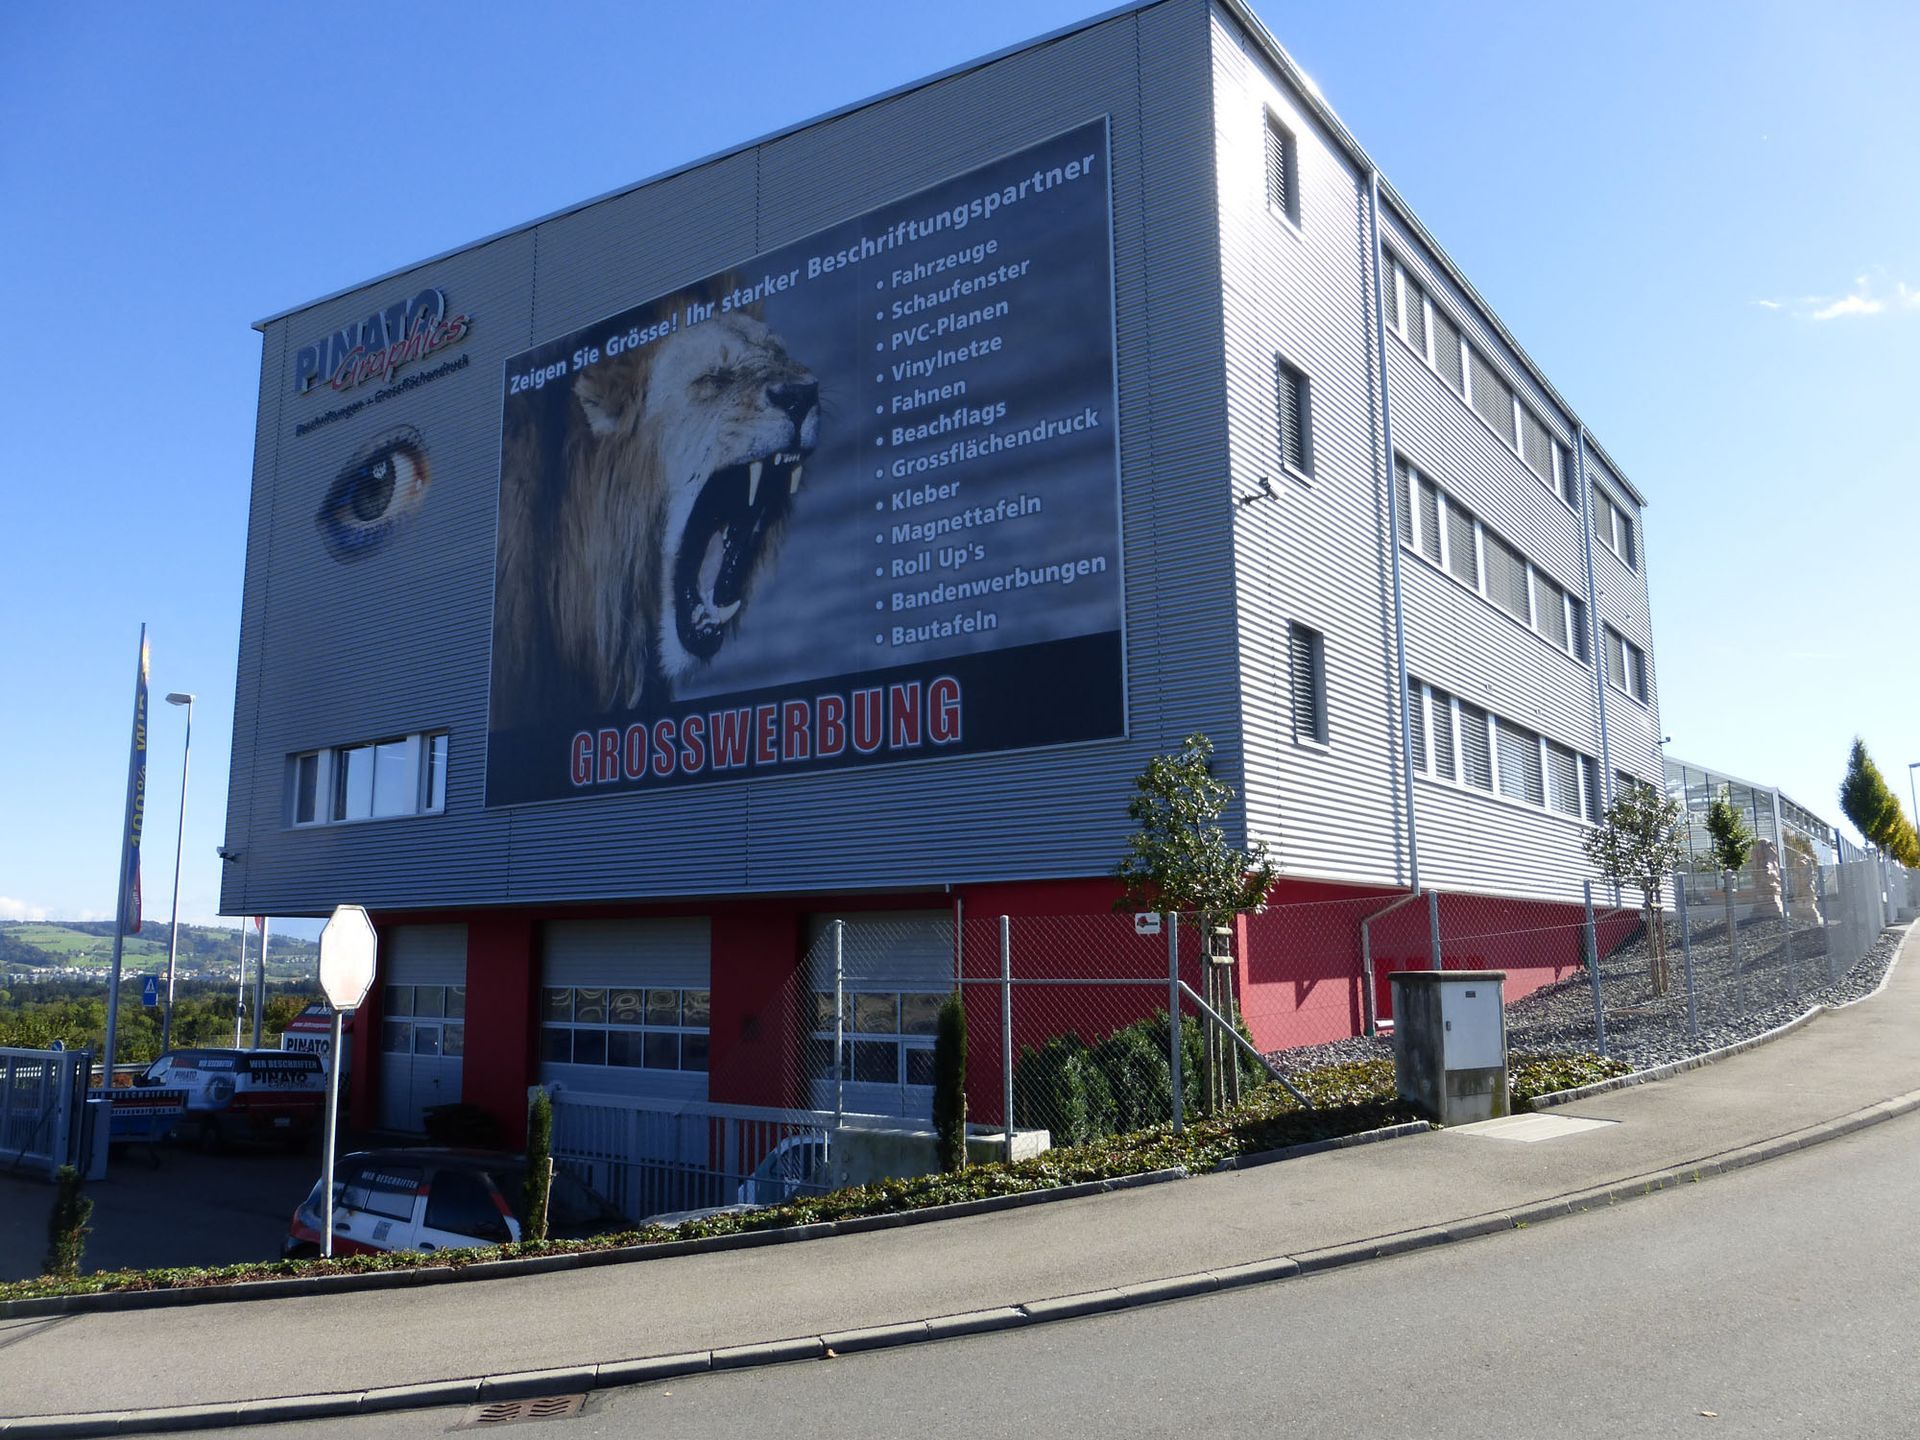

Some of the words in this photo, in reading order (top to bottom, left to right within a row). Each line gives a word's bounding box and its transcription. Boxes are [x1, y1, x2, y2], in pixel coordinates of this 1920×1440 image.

[510, 360, 567, 395] Zeigen
[572, 346, 599, 371] Sie
[605, 313, 678, 357] Grösse!
[685, 302, 714, 328] Ihr
[721, 266, 800, 314] starker
[807, 153, 1095, 281] Beschriftungspartner
[891, 239, 998, 289] Fahrzeuge
[891, 259, 1030, 320] Schaufenster
[294, 287, 445, 394] PINATO
[891, 300, 1009, 350] PVC-Planen
[331, 313, 471, 391] Graphics
[891, 335, 1003, 383] Vinylnetze
[891, 379, 967, 414] Fahnen
[891, 400, 1007, 446] Beachflags
[891, 407, 1099, 478] Grossflächendruck
[891, 481, 961, 511] Kleber
[891, 495, 1042, 545] Magnettafeln
[891, 551, 931, 578] Roll
[938, 543, 986, 570] Up's
[891, 555, 1107, 612] Bandenwerbungen
[891, 610, 998, 645] Bautafeln
[570, 675, 962, 788] GROSSWERBUNG
[286, 1038, 330, 1053] PINATO
[251, 1072, 307, 1084] PINATO
